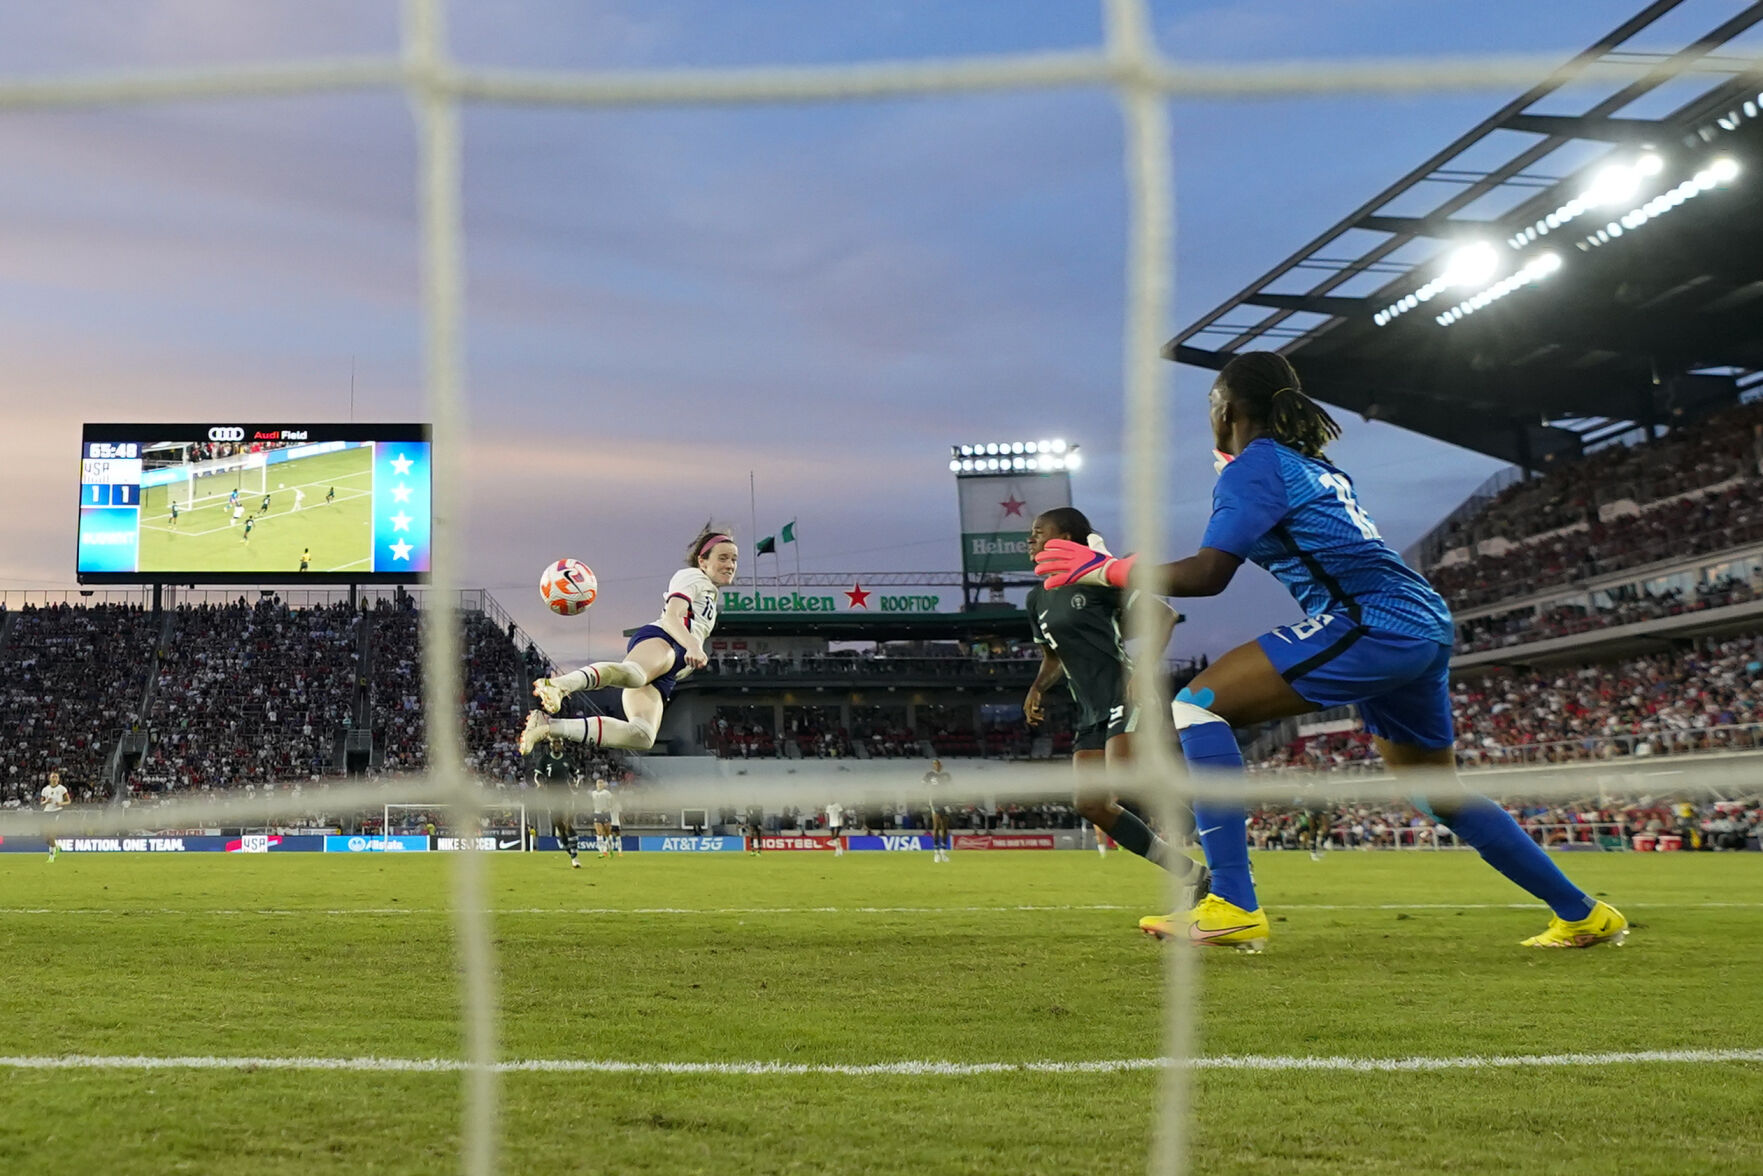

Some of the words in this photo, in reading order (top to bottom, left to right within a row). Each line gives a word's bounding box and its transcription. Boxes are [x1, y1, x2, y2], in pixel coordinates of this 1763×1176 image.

[254, 431, 279, 439] Audi
[281, 431, 307, 440] Field
[92, 485, 99, 502] 1
[121, 485, 129, 503] 1
[972, 538, 1030, 554] Heine
[722, 591, 835, 611] Heineken
[880, 595, 939, 611] ROOFTOP
[123, 839, 147, 851] ONE
[149, 839, 185, 851] TEAM.
[437, 838, 459, 850] NIKE
[662, 838, 699, 850] AT&T
[699, 838, 723, 850] 5G
[880, 836, 921, 850] VISA
